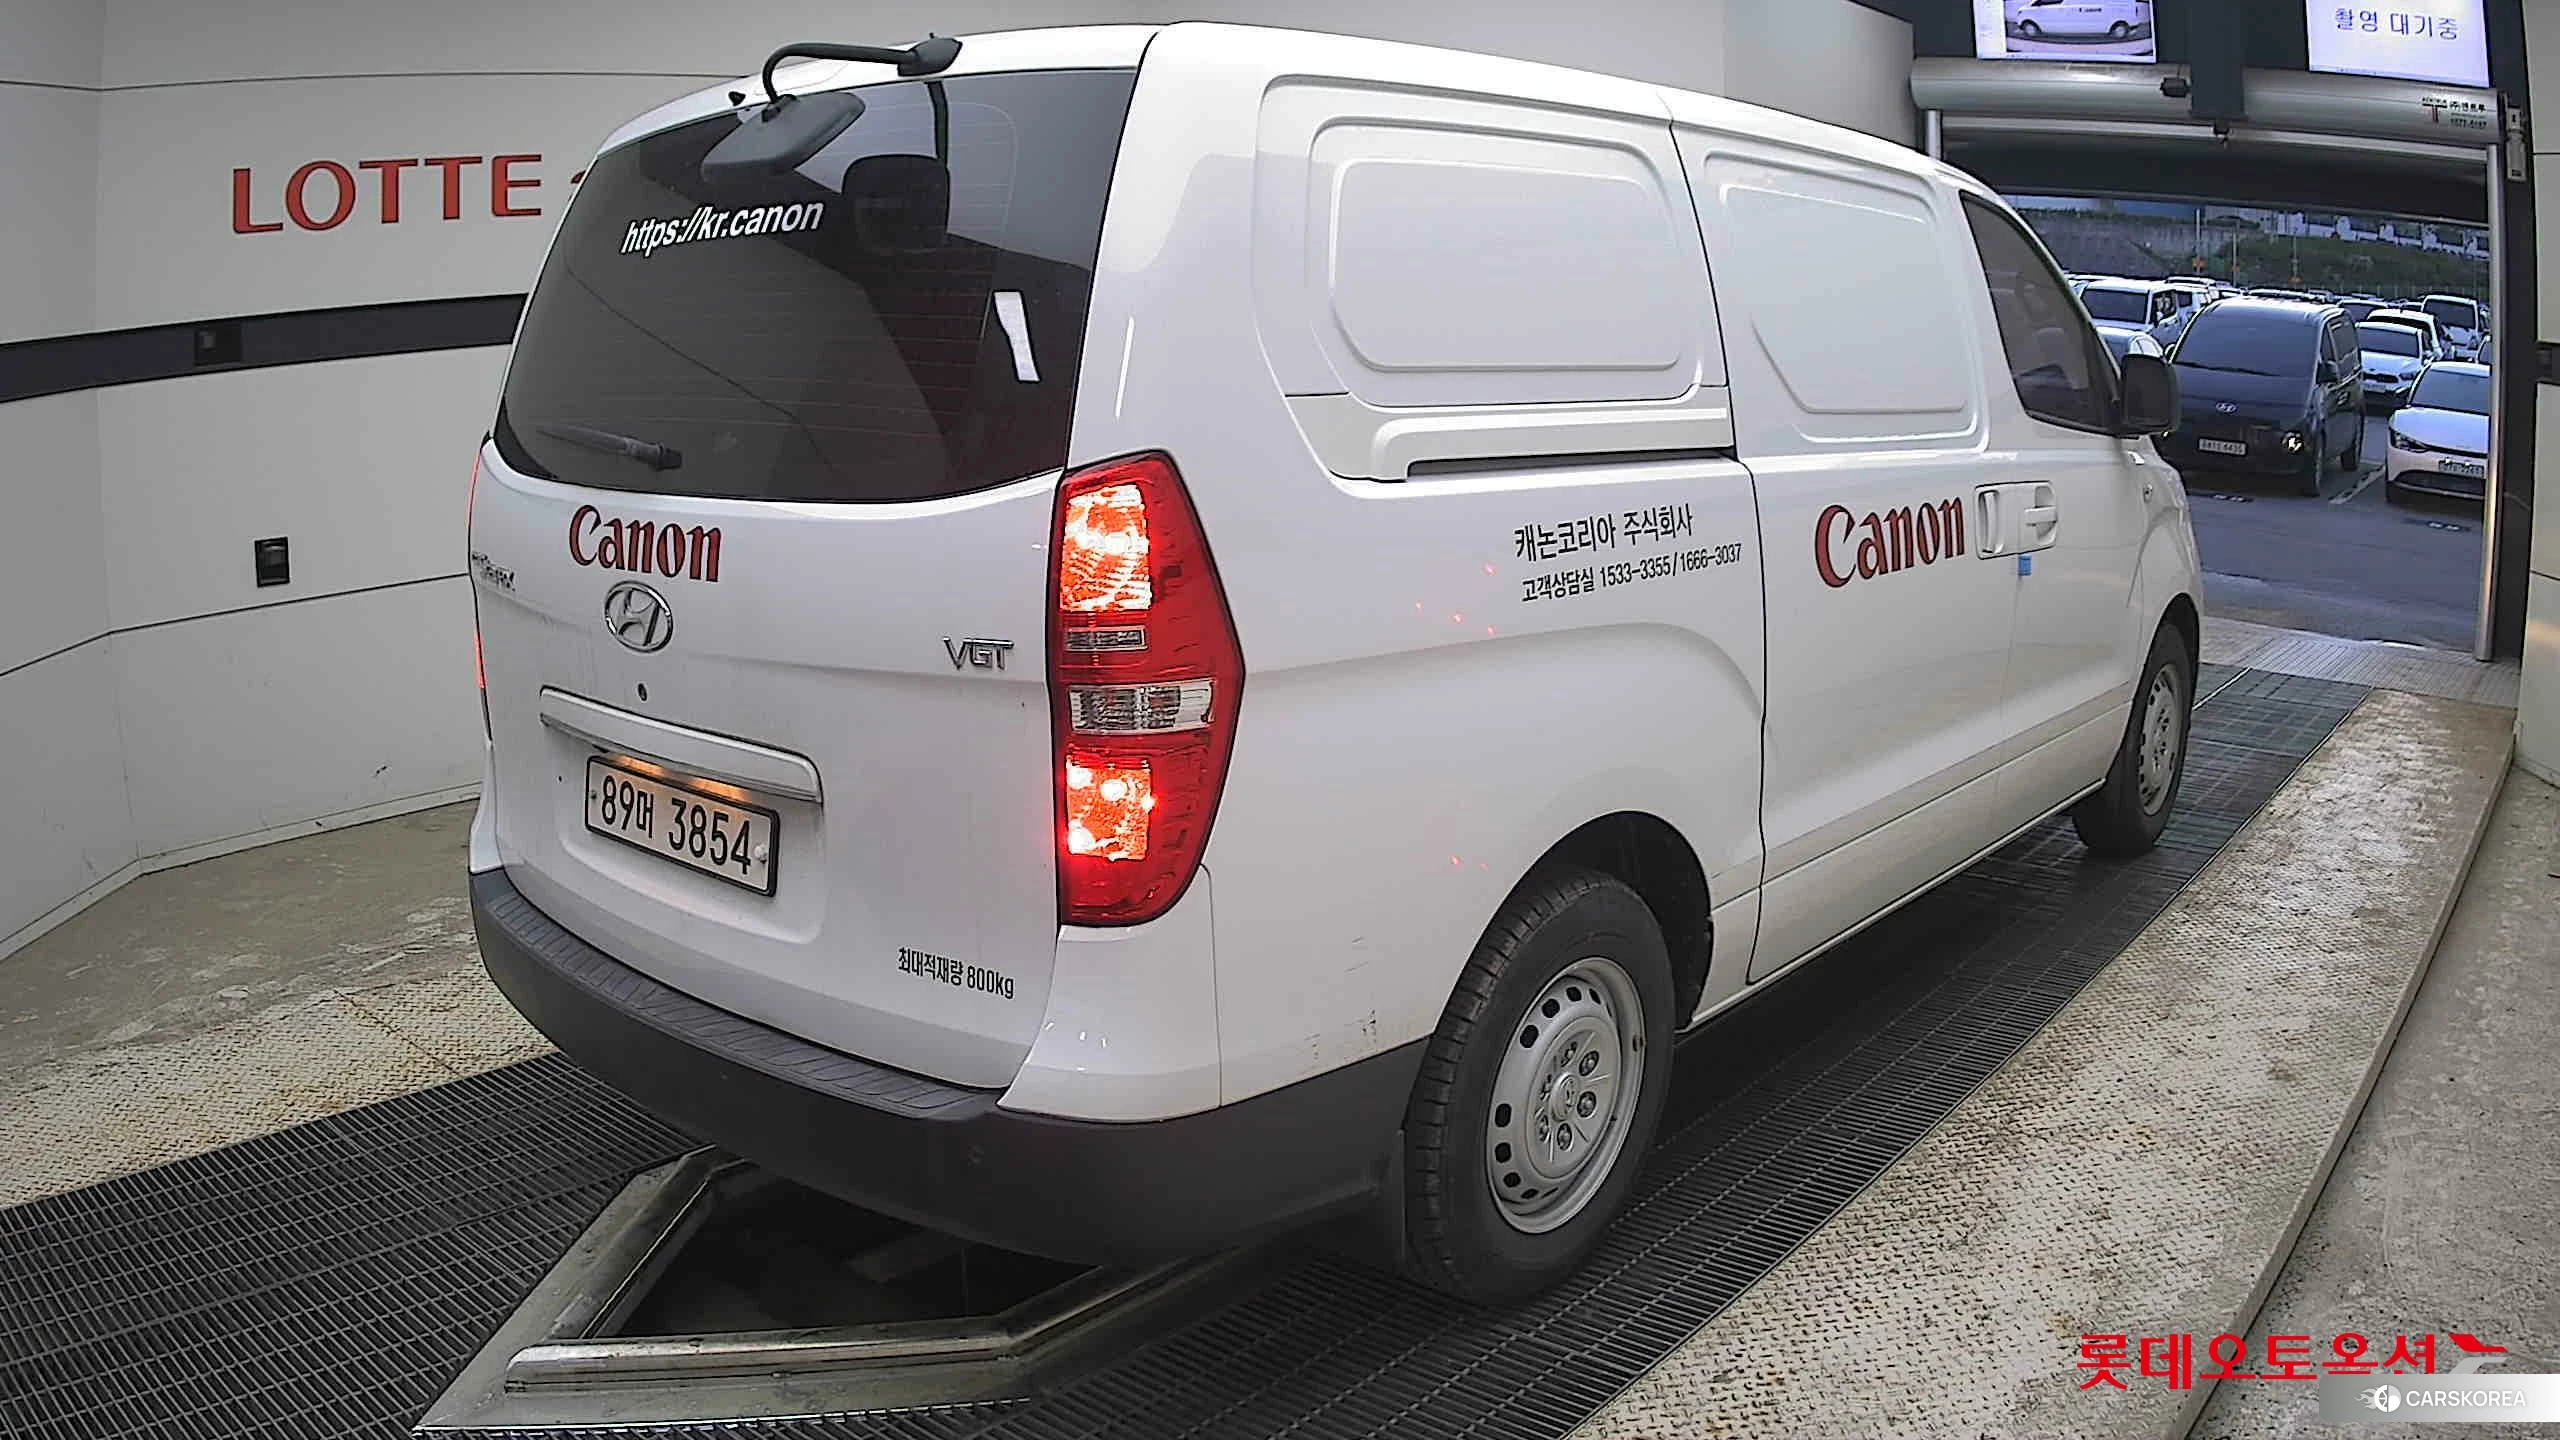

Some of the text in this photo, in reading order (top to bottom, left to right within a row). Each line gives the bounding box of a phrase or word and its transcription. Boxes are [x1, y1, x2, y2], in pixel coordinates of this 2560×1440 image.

[2335, 8, 2458, 40] 촬영 대기중
[232, 153, 542, 234] LOTTE
[620, 201, 825, 257] https://kr.canon
[569, 504, 722, 583] Canon
[1514, 503, 1693, 562] 캐논코리아 주식회사
[1814, 496, 1966, 588] Canon
[1521, 567, 1595, 602] 고객상담실
[943, 636, 1015, 670] VGT
[601, 774, 751, 875] 89머 3854
[898, 947, 1014, 999] 최대적재량 800kg
